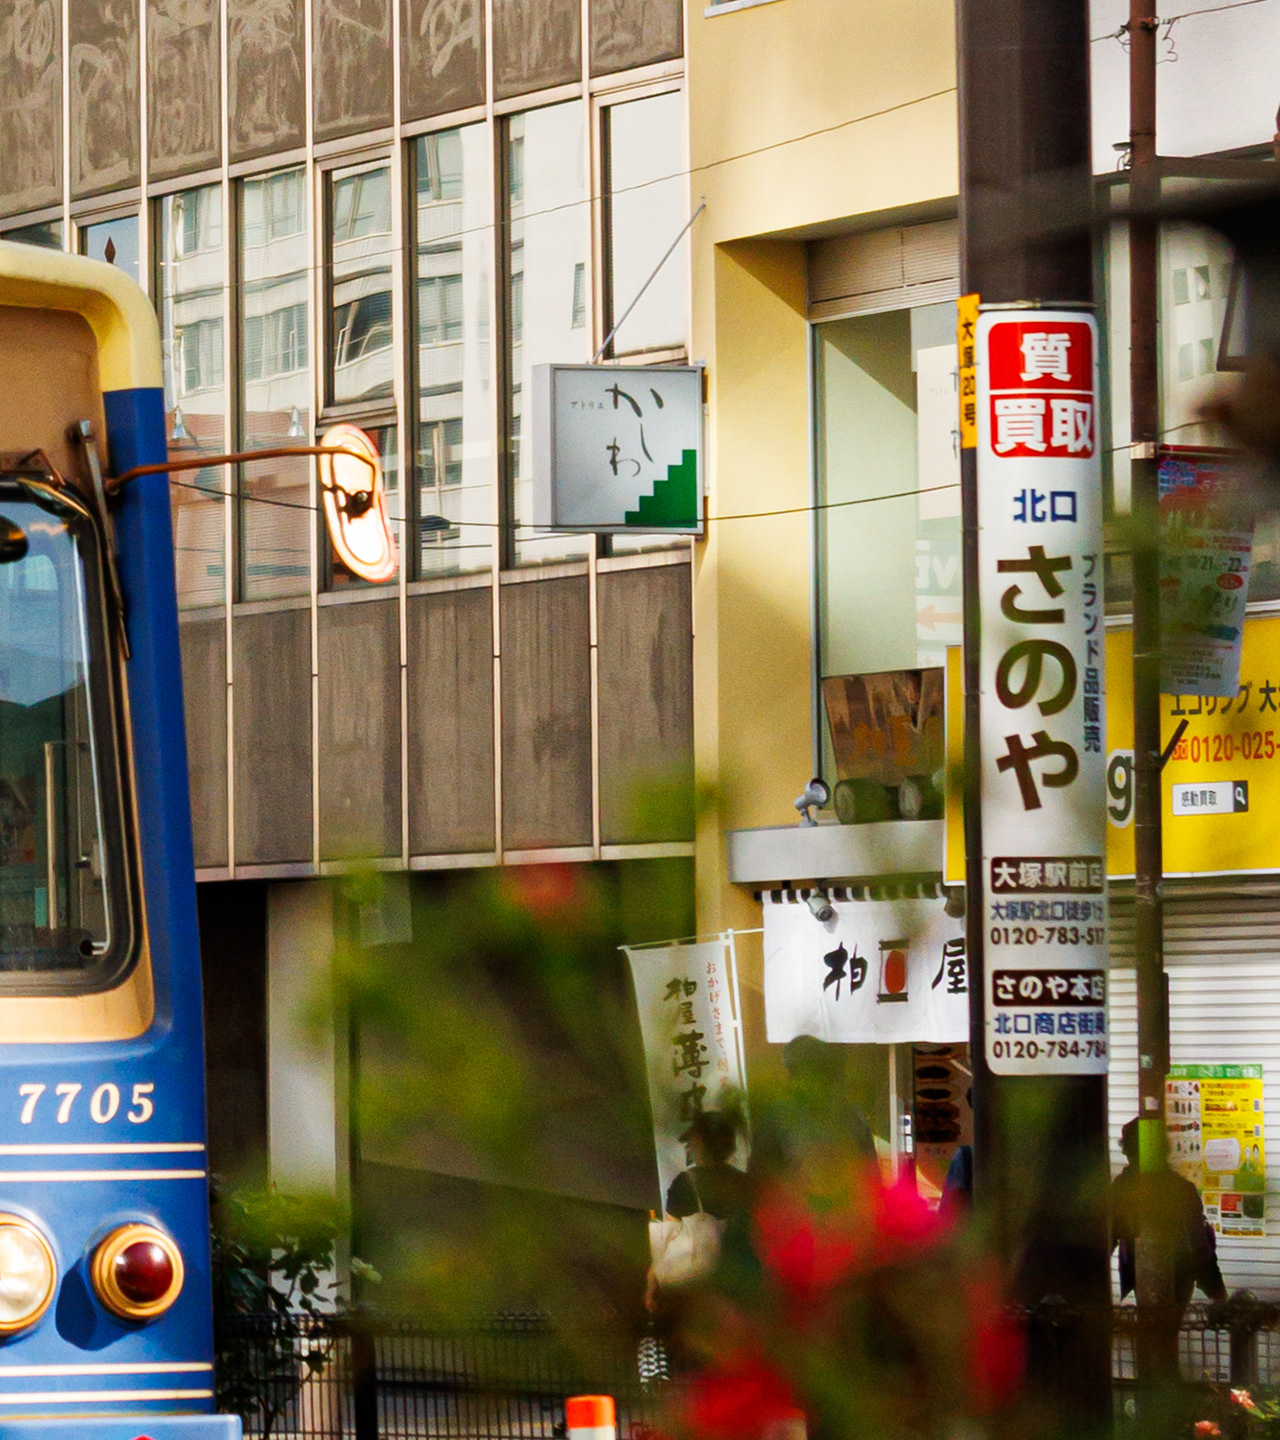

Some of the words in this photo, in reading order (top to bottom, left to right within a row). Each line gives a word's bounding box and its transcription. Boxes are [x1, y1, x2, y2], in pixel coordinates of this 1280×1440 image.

[1019, 331, 1073, 382] 質
[994, 397, 1094, 454] 買取
[1013, 488, 1078, 523] 北口
[994, 545, 1081, 811] さのや
[19, 1082, 155, 1125] 7705
